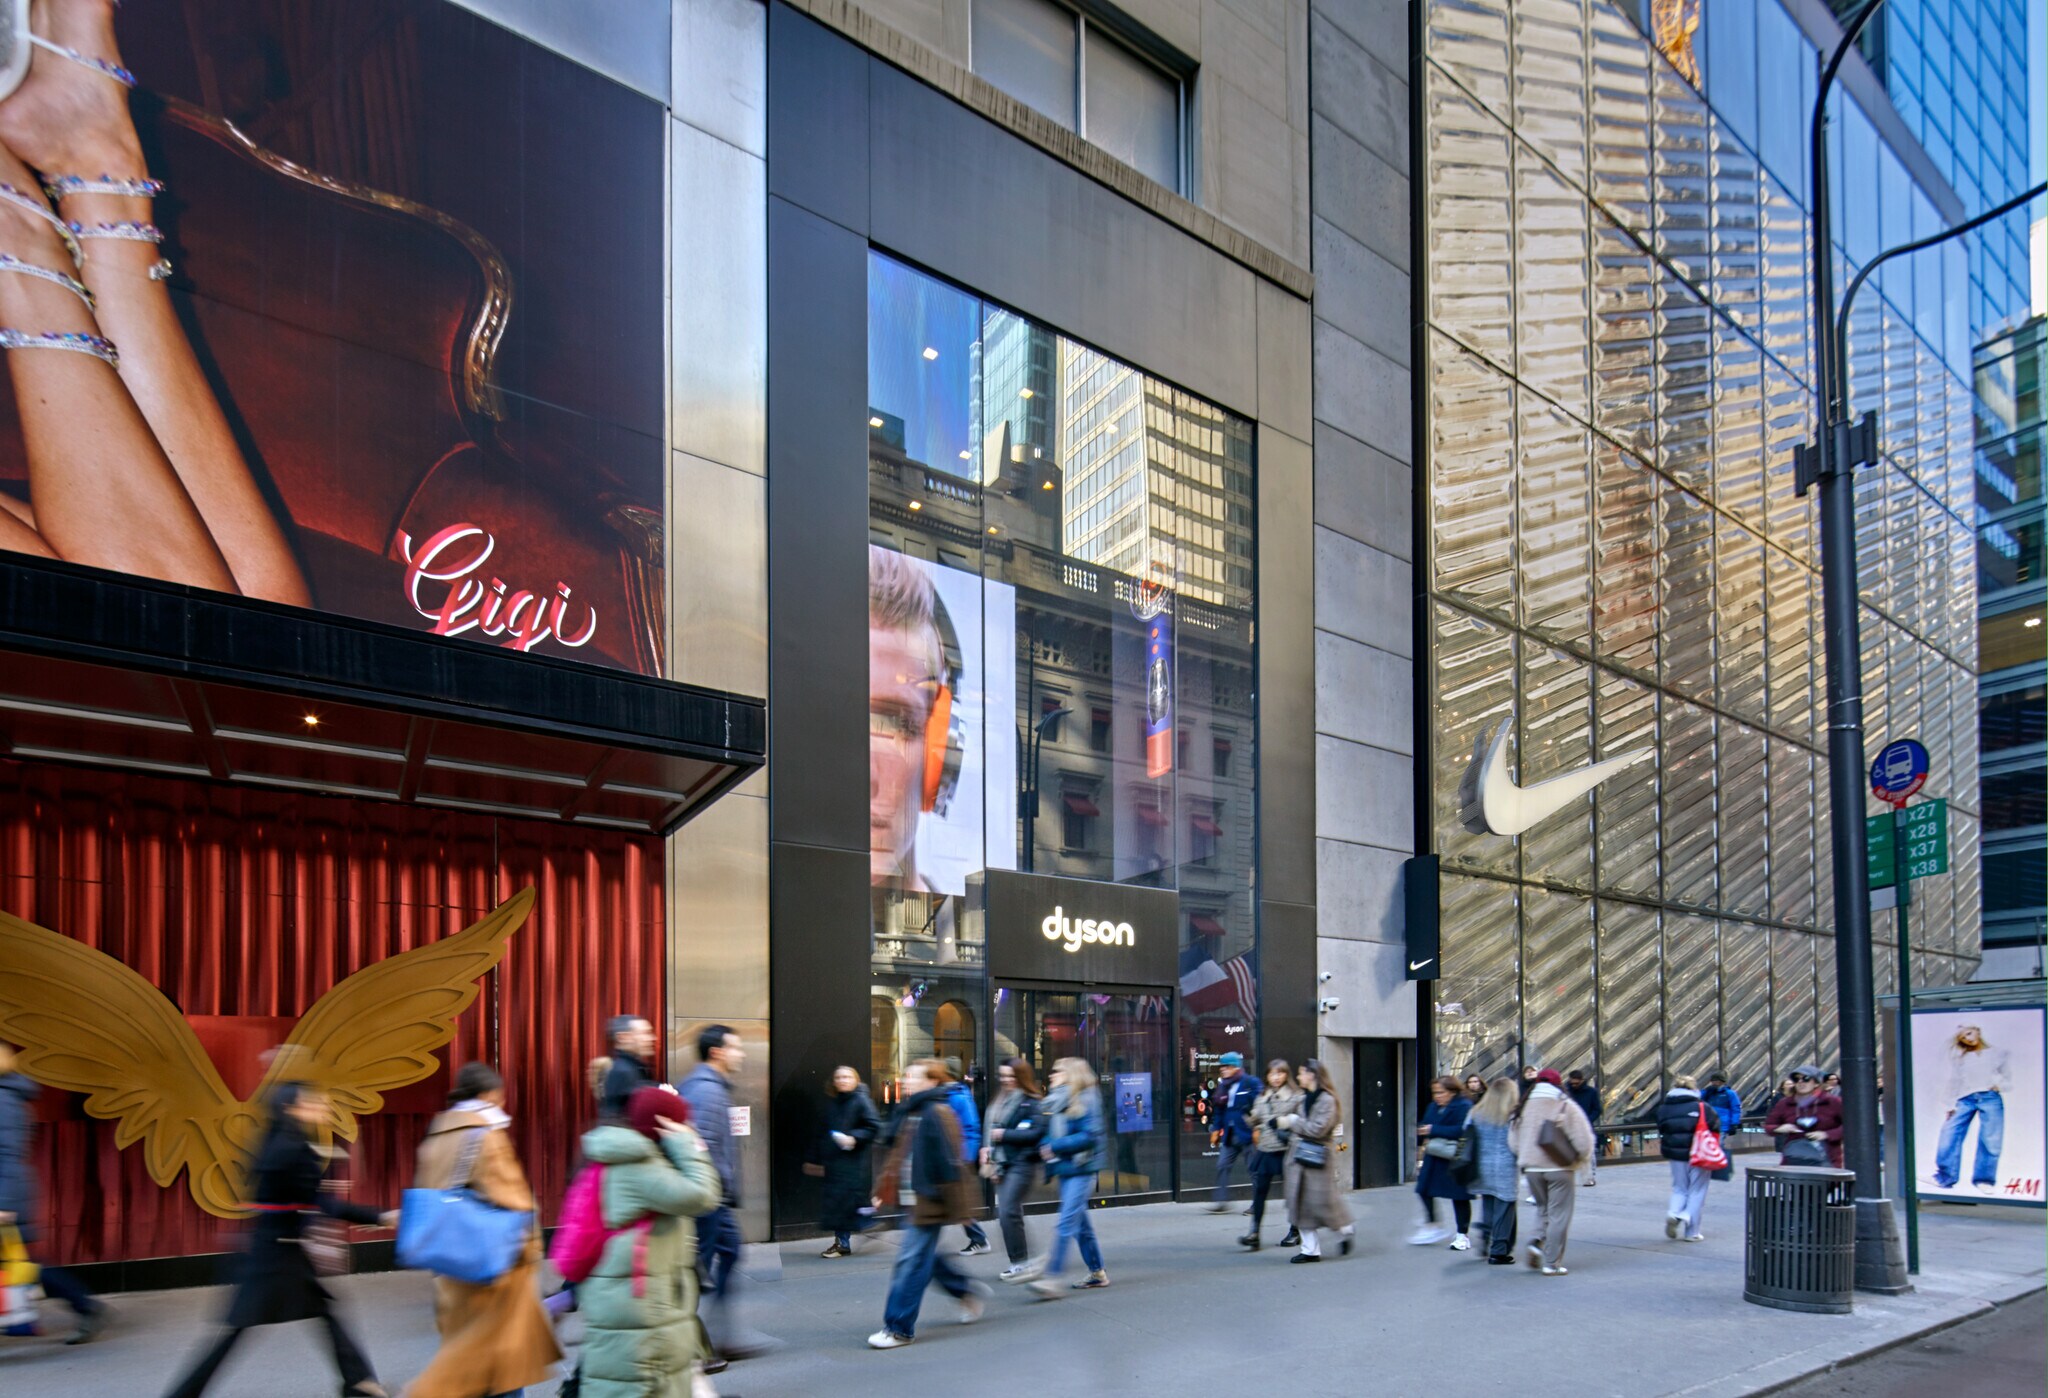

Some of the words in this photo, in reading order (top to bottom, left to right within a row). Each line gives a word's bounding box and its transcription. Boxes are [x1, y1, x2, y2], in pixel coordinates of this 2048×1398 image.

[1909, 803, 1936, 822] x27
[1909, 821, 1937, 840] x28
[1910, 840, 1937, 858] x37
[1910, 859, 1937, 877] x38
[1042, 905, 1135, 953] dyson
[1224, 1024, 1244, 1035] dyson
[2003, 1177, 2041, 1196] H&M
